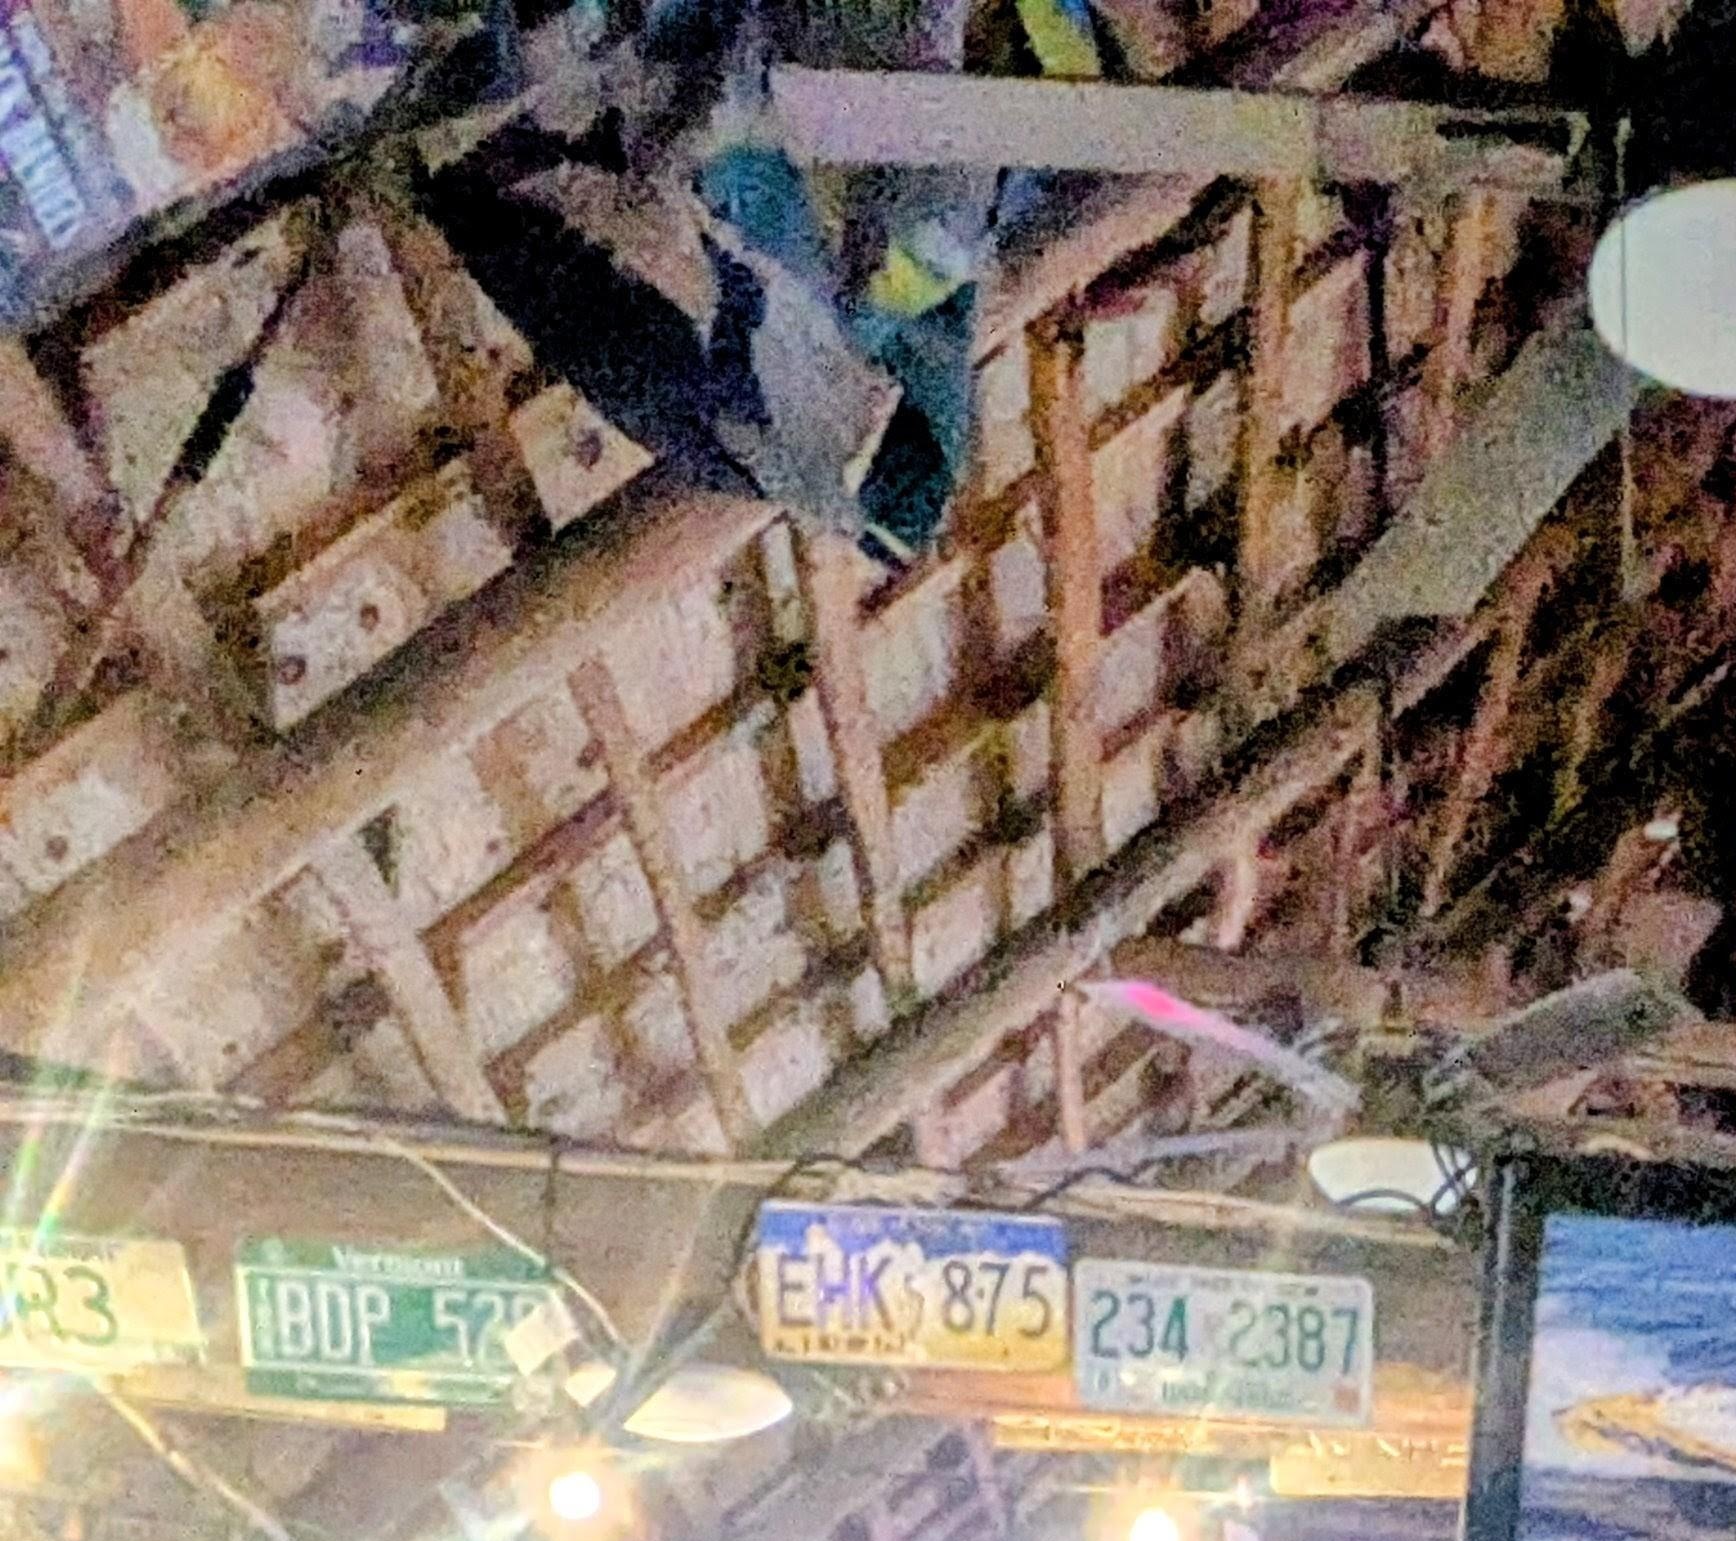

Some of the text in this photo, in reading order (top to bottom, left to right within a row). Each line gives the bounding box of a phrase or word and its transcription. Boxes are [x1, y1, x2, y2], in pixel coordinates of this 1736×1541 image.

[276, 1279, 391, 1367] BDP
[1091, 1289, 1358, 1376] 234 2387
